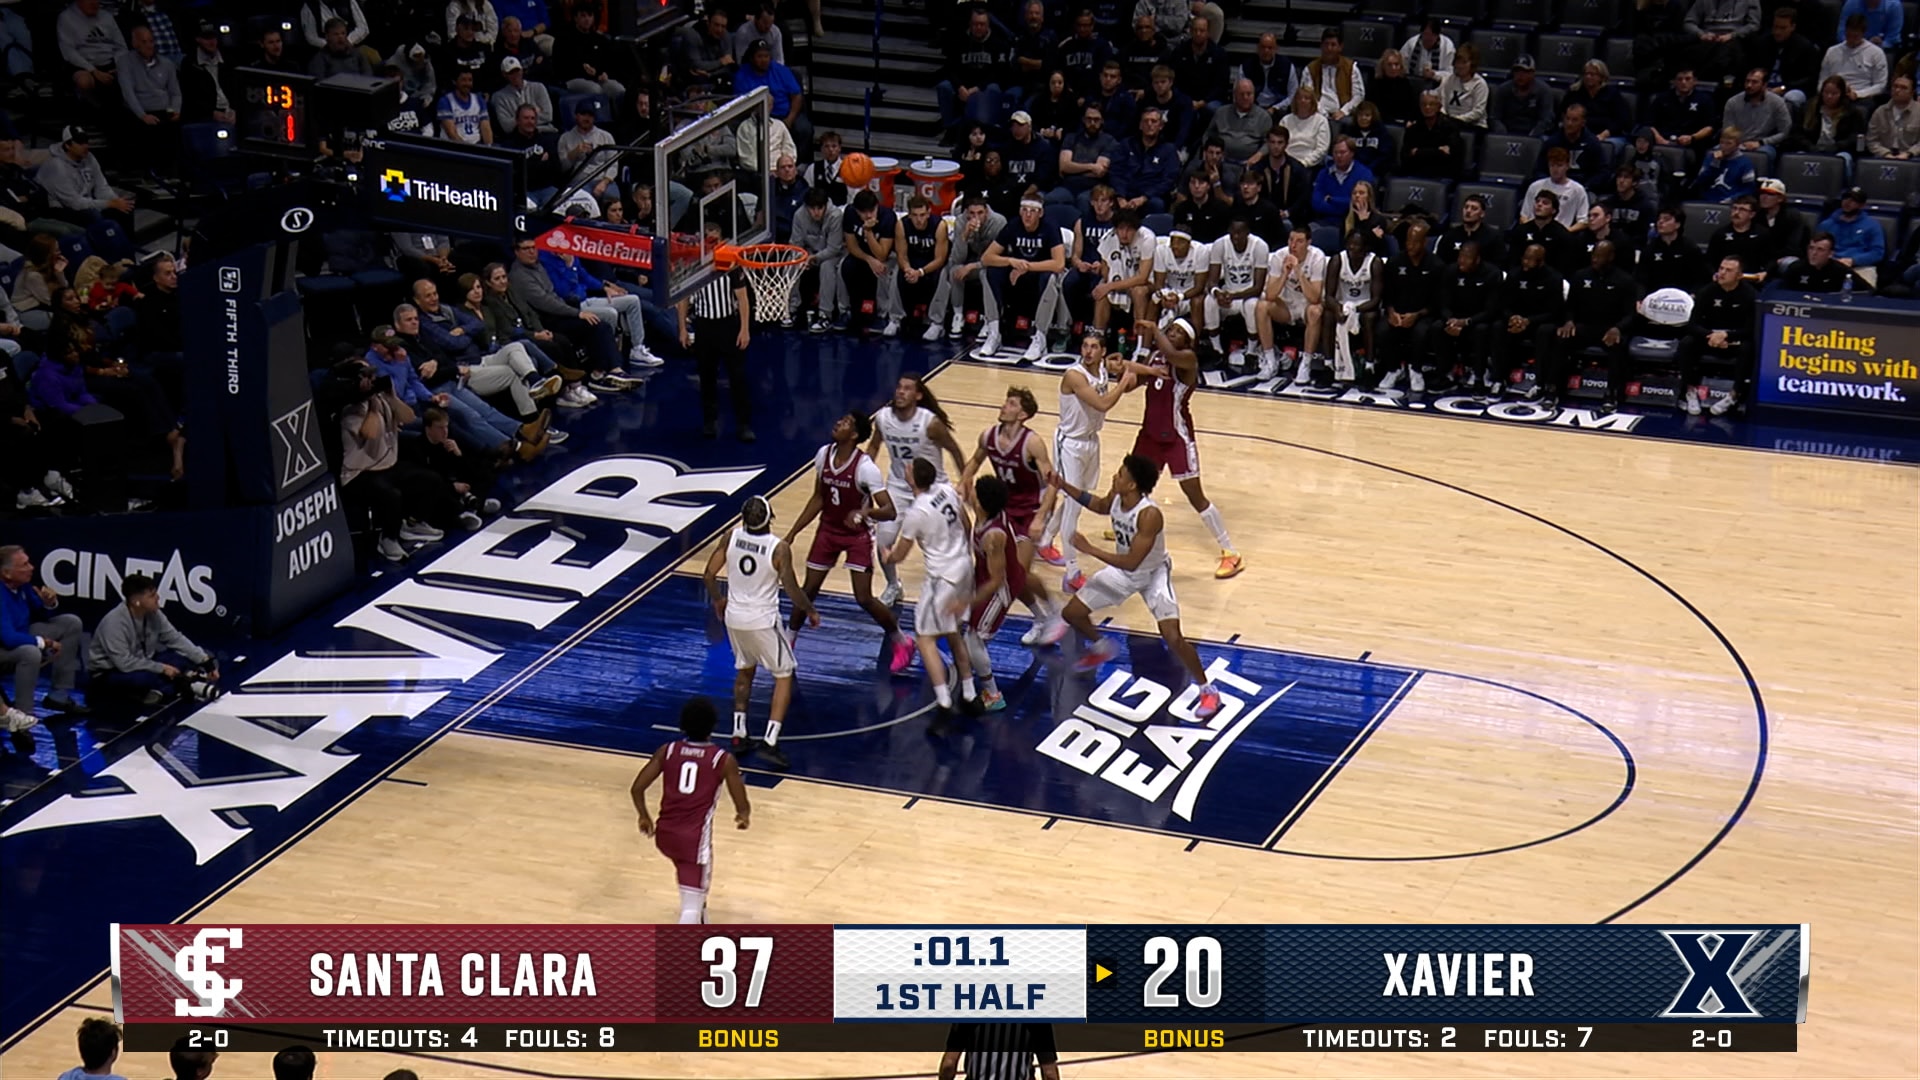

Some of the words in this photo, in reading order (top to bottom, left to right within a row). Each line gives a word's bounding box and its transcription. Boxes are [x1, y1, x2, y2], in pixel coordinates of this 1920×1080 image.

[266, 85, 293, 109] 1.3
[412, 179, 498, 212] TriHealth
[921, 184, 934, 197] G
[1228, 273, 1251, 284] 22
[225, 298, 238, 343] FIFTH
[1772, 304, 1812, 318] anc
[1780, 325, 1876, 356] Healing
[227, 347, 240, 394] THIRD
[1778, 349, 1857, 376] begins
[1862, 358, 1918, 380] with
[1641, 386, 1675, 397] TOYOTA
[1777, 374, 1907, 402] teamwork.
[272, 400, 322, 489] X
[891, 445, 914, 460] 12
[830, 486, 841, 506] 3
[276, 483, 338, 543] JOSEPH
[941, 503, 957, 527] 3
[289, 530, 333, 580] AUTO
[739, 554, 757, 576] 0
[0, 453, 767, 866] XAVIER
[1035, 668, 1172, 775] BIG
[1099, 656, 1262, 803] EAST
[678, 761, 699, 794] 0
